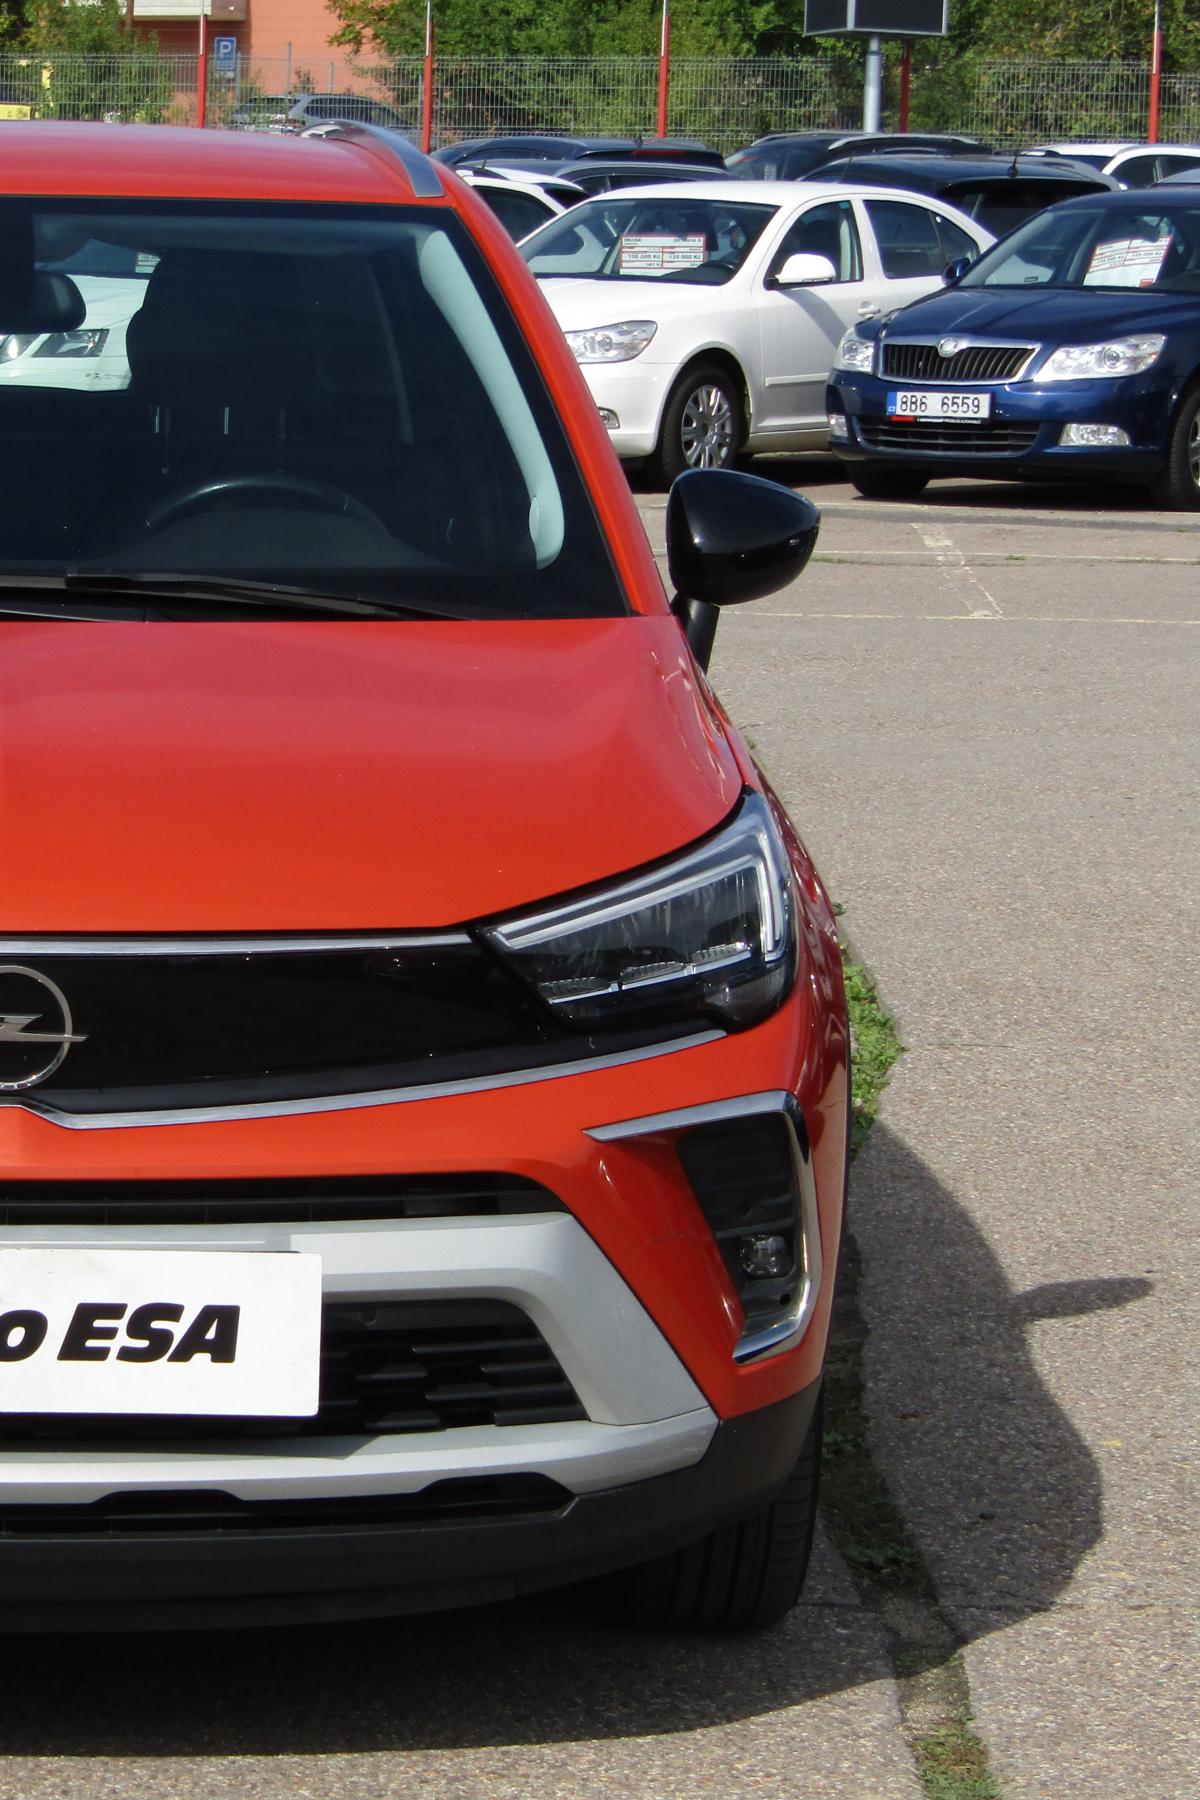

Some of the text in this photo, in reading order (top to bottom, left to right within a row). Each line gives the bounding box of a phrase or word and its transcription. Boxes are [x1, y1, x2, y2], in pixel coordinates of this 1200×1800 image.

[220, 41, 231, 59] P
[900, 395, 980, 414] 8B6 6559
[56, 1302, 241, 1363] ESA
